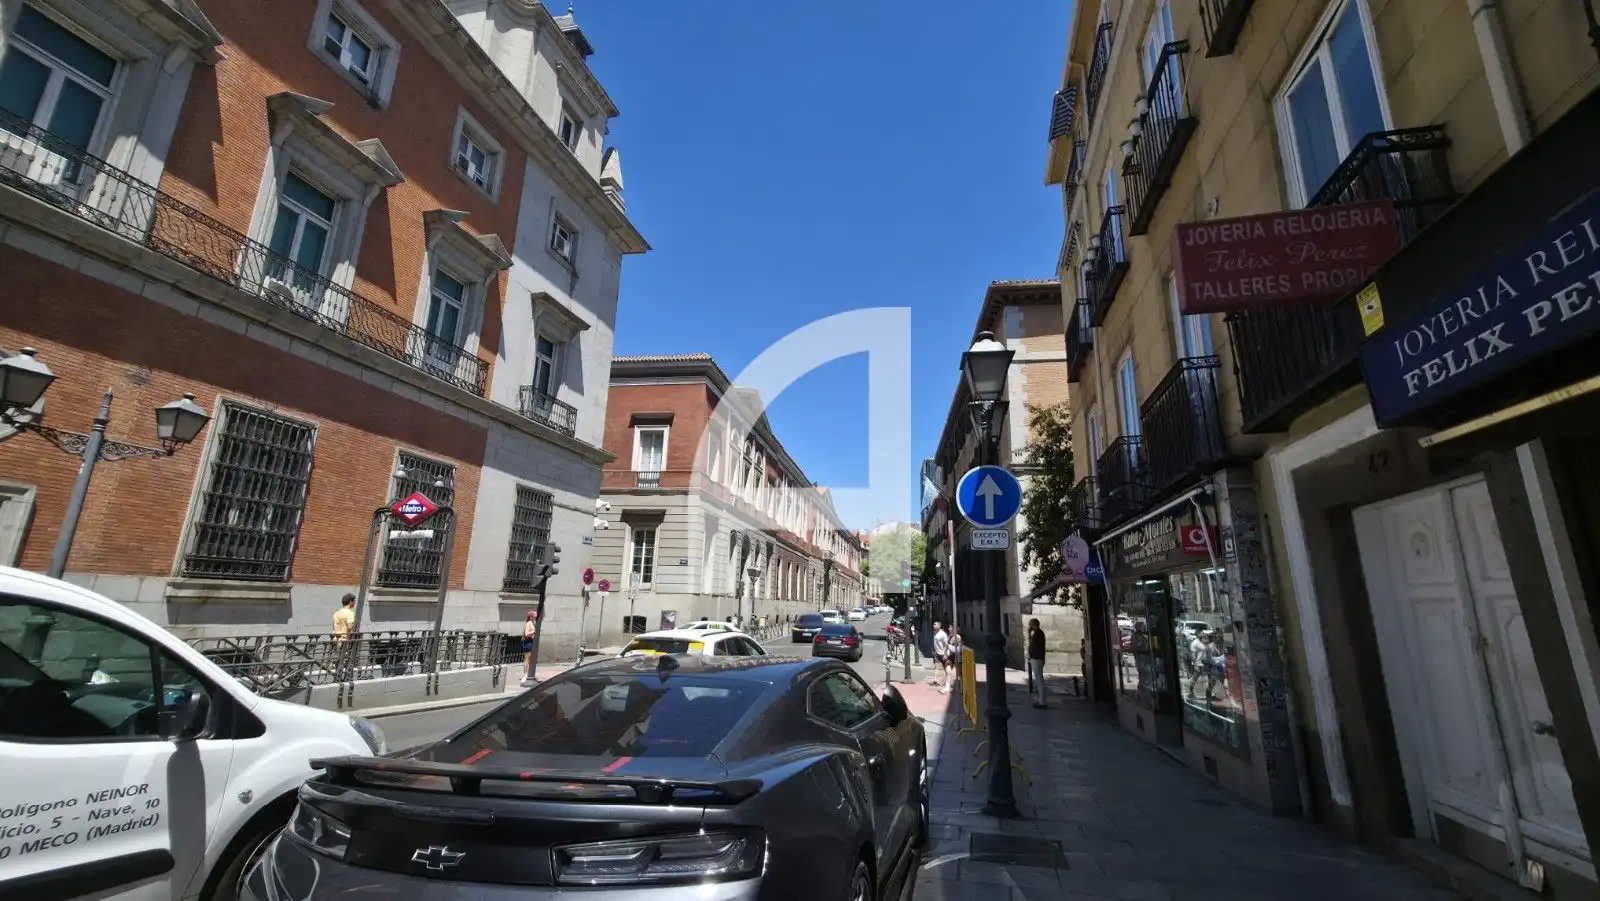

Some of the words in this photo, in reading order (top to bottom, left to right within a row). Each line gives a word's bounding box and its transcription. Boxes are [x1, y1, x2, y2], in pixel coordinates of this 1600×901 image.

[1185, 221, 1266, 246] JOYERIA
[1274, 207, 1388, 237] RELOJERIA
[1205, 248, 1278, 273] Felix
[1285, 240, 1370, 265] Perez
[1191, 274, 1291, 300] TALLERES
[1394, 274, 1519, 369] JOYERIA
[1403, 321, 1513, 397] FELIX
[402, 504, 422, 513] Metro
[974, 531, 1007, 539] EXCEPTO
[0, 798, 78, 819] olígono
[86, 783, 149, 804] NEINOR
[0, 822, 41, 840] icio,
[50, 816, 63, 829] 5
[87, 804, 136, 821] Nave,
[145, 798, 160, 809] 10
[19, 831, 79, 855] MECO
[87, 812, 160, 841] (Madrid)
